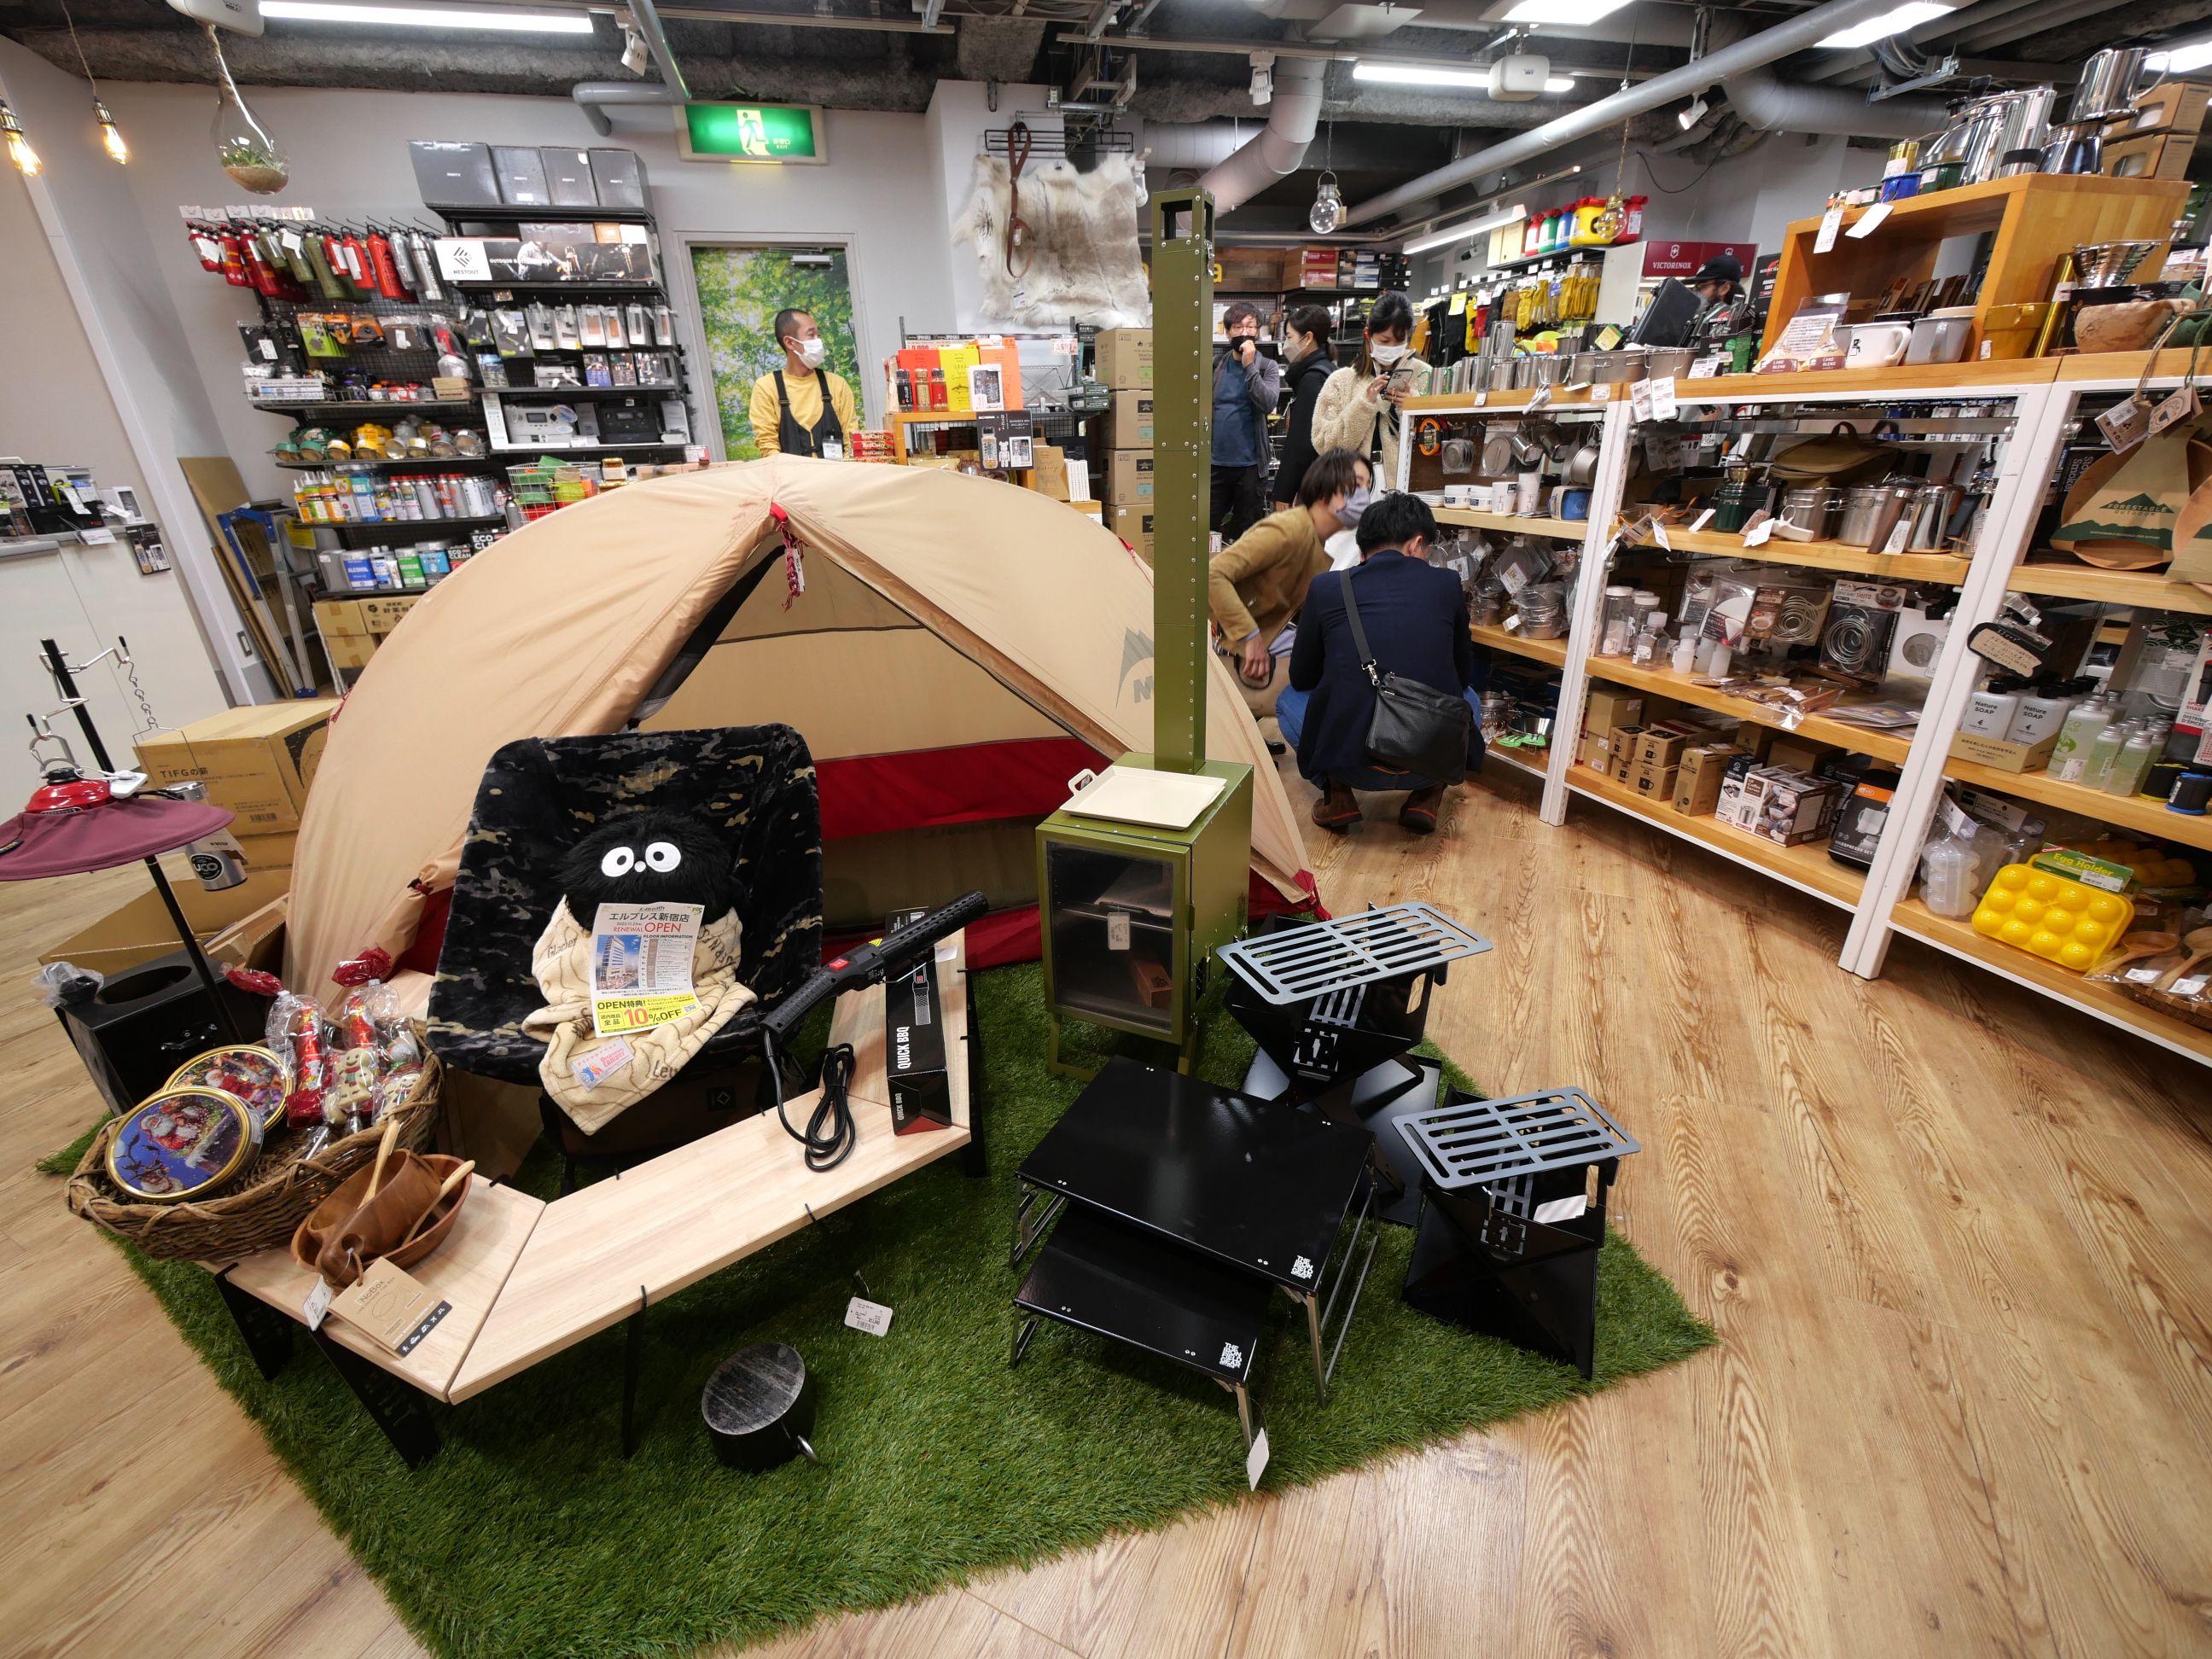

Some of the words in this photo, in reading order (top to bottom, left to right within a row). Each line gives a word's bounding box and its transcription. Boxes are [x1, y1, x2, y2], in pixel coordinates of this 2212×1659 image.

[1652, 261, 1692, 270] VICTORINOX
[2108, 504, 2168, 512] FORESTABLE
[1975, 701, 1998, 709] Nature
[2023, 705, 2046, 714] Nature
[2052, 853, 2075, 867] Egg
[2075, 859, 2115, 876] Holder
[608, 912, 690, 923] エルブレス新宿店
[644, 923, 682, 933] OPEN
[597, 999, 646, 1010] OPEN特典!
[897, 1026, 910, 1043] BBQ
[602, 1051, 626, 1067] Camper
[897, 1044, 911, 1069] QUICK
[895, 1103, 904, 1121] QUICK
